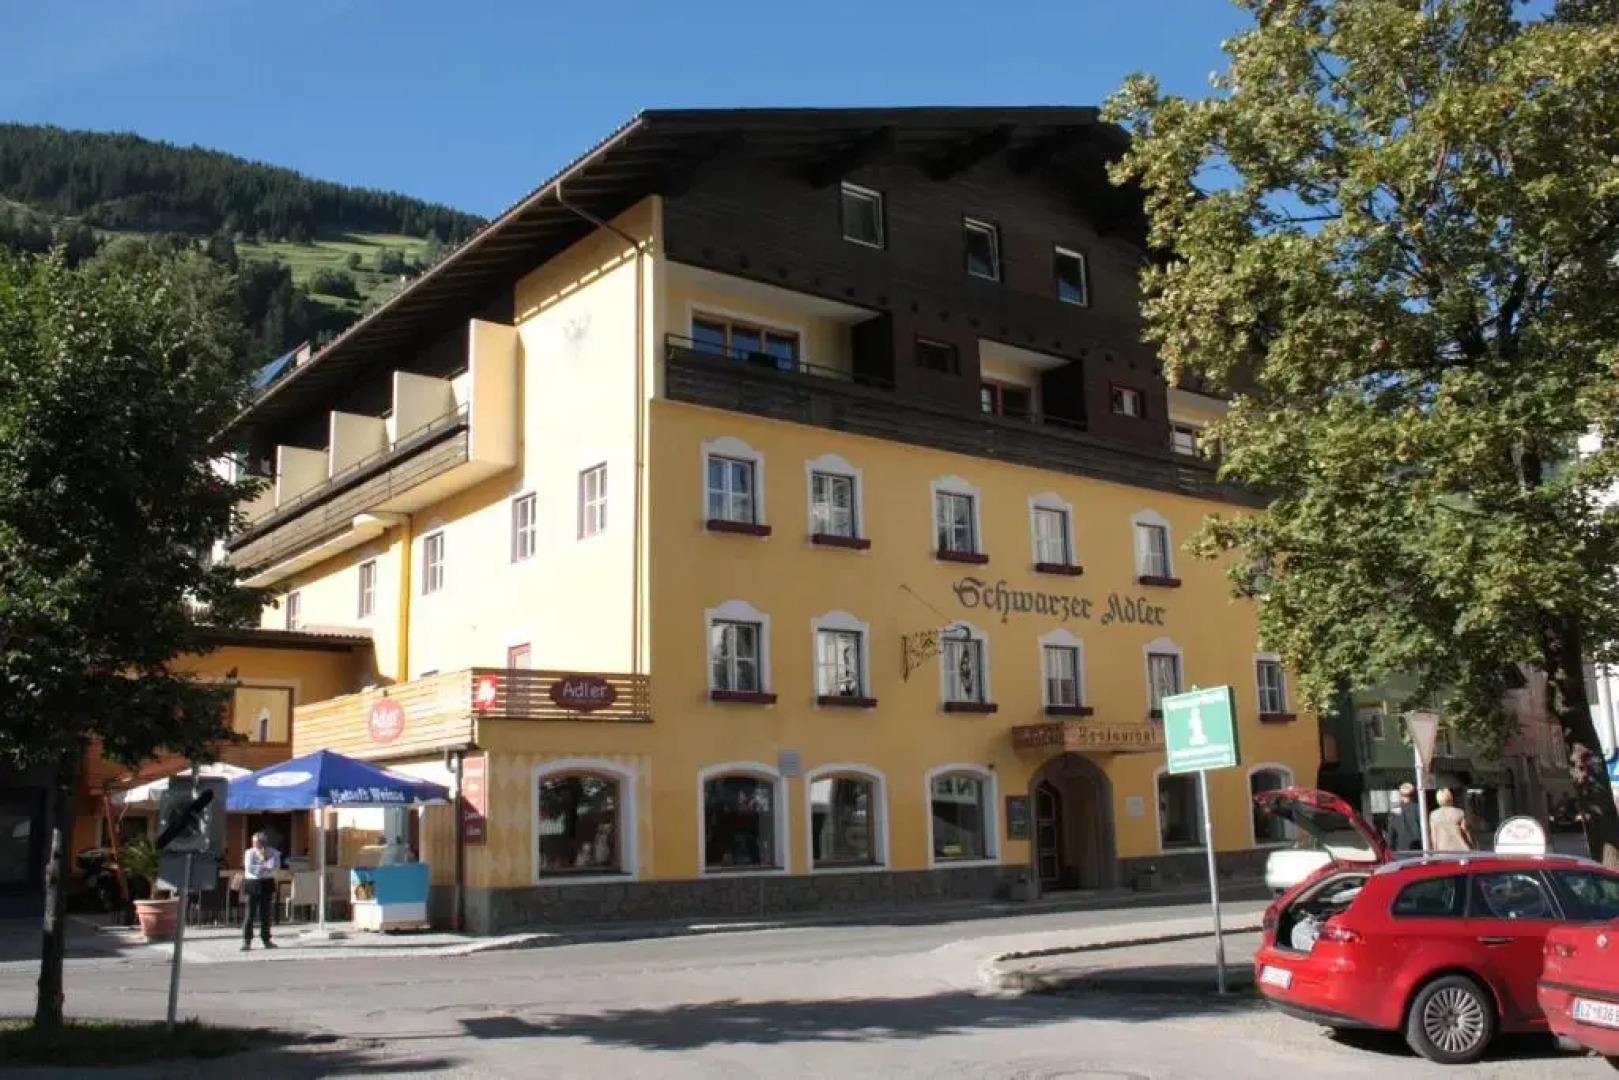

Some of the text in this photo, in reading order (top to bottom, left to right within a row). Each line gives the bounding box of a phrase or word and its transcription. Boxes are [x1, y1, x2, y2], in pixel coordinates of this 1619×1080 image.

[952, 576, 1168, 626] Schwarzer Adler
[562, 681, 607, 698] Adler
